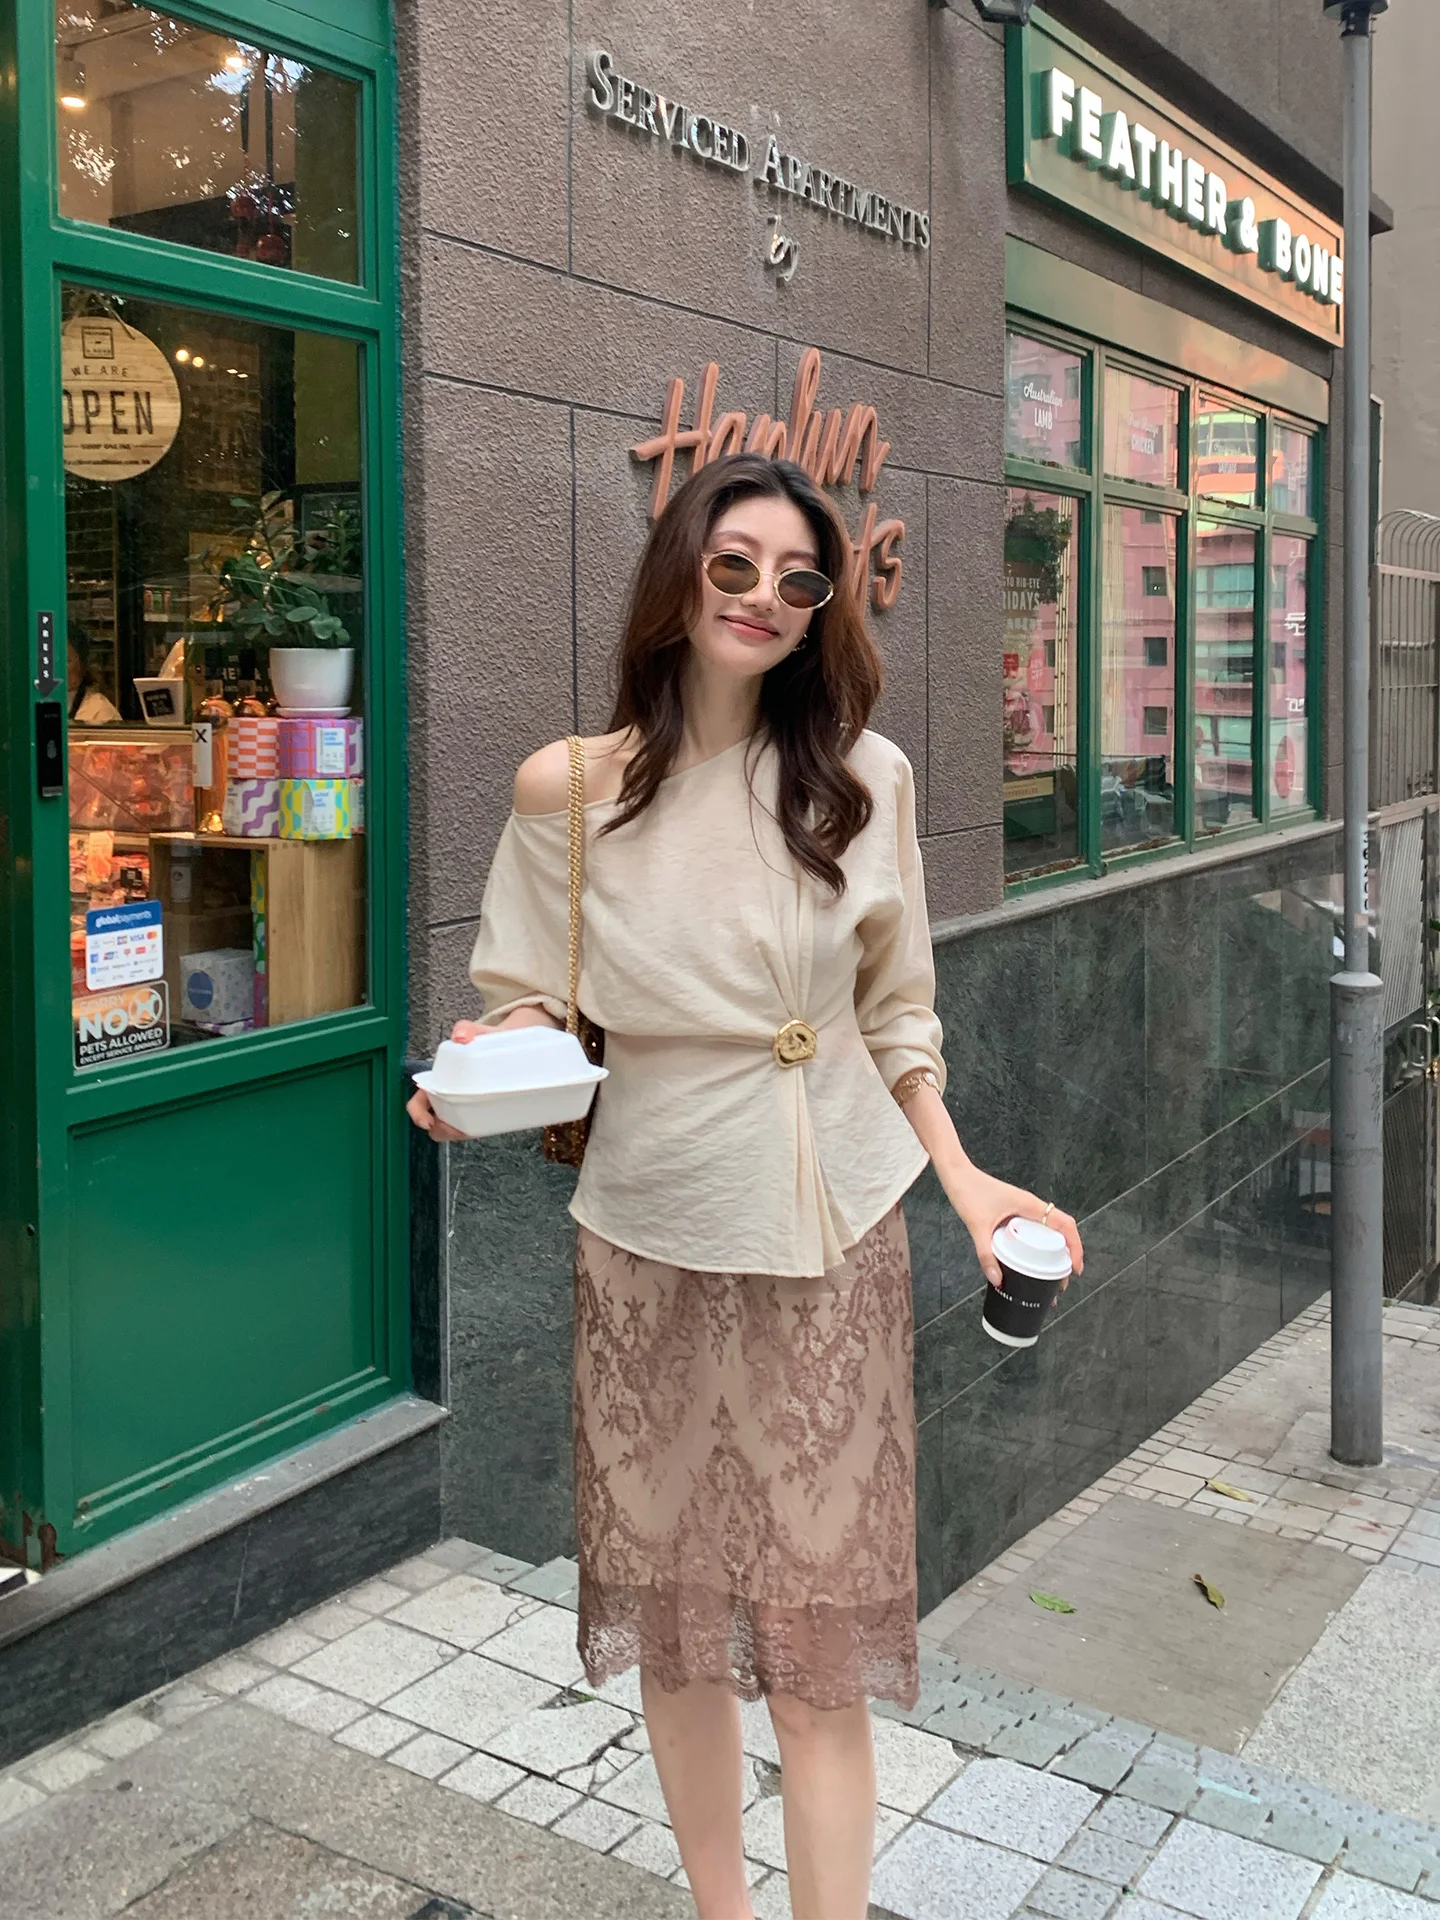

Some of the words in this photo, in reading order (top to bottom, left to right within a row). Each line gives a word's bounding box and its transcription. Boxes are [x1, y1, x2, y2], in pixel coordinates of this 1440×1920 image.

[586, 50, 751, 172] SERVICED
[756, 134, 931, 248] APARTMENTS
[1047, 66, 1227, 237] FEATHER
[1238, 197, 1260, 253] &
[1274, 217, 1344, 305] BONE
[768, 214, 800, 282] by
[70, 365, 91, 377] WE
[100, 365, 129, 377] ARE
[62, 388, 154, 435] OPEN
[1023, 382, 1063, 408] Australian
[1034, 407, 1053, 430] LAMB
[42, 616, 50, 679] PRESS
[130, 934, 145, 942] VISA
[79, 1008, 128, 1043] NO
[79, 1041, 107, 1056] PETS
[109, 1028, 163, 1049] ALLOWED
